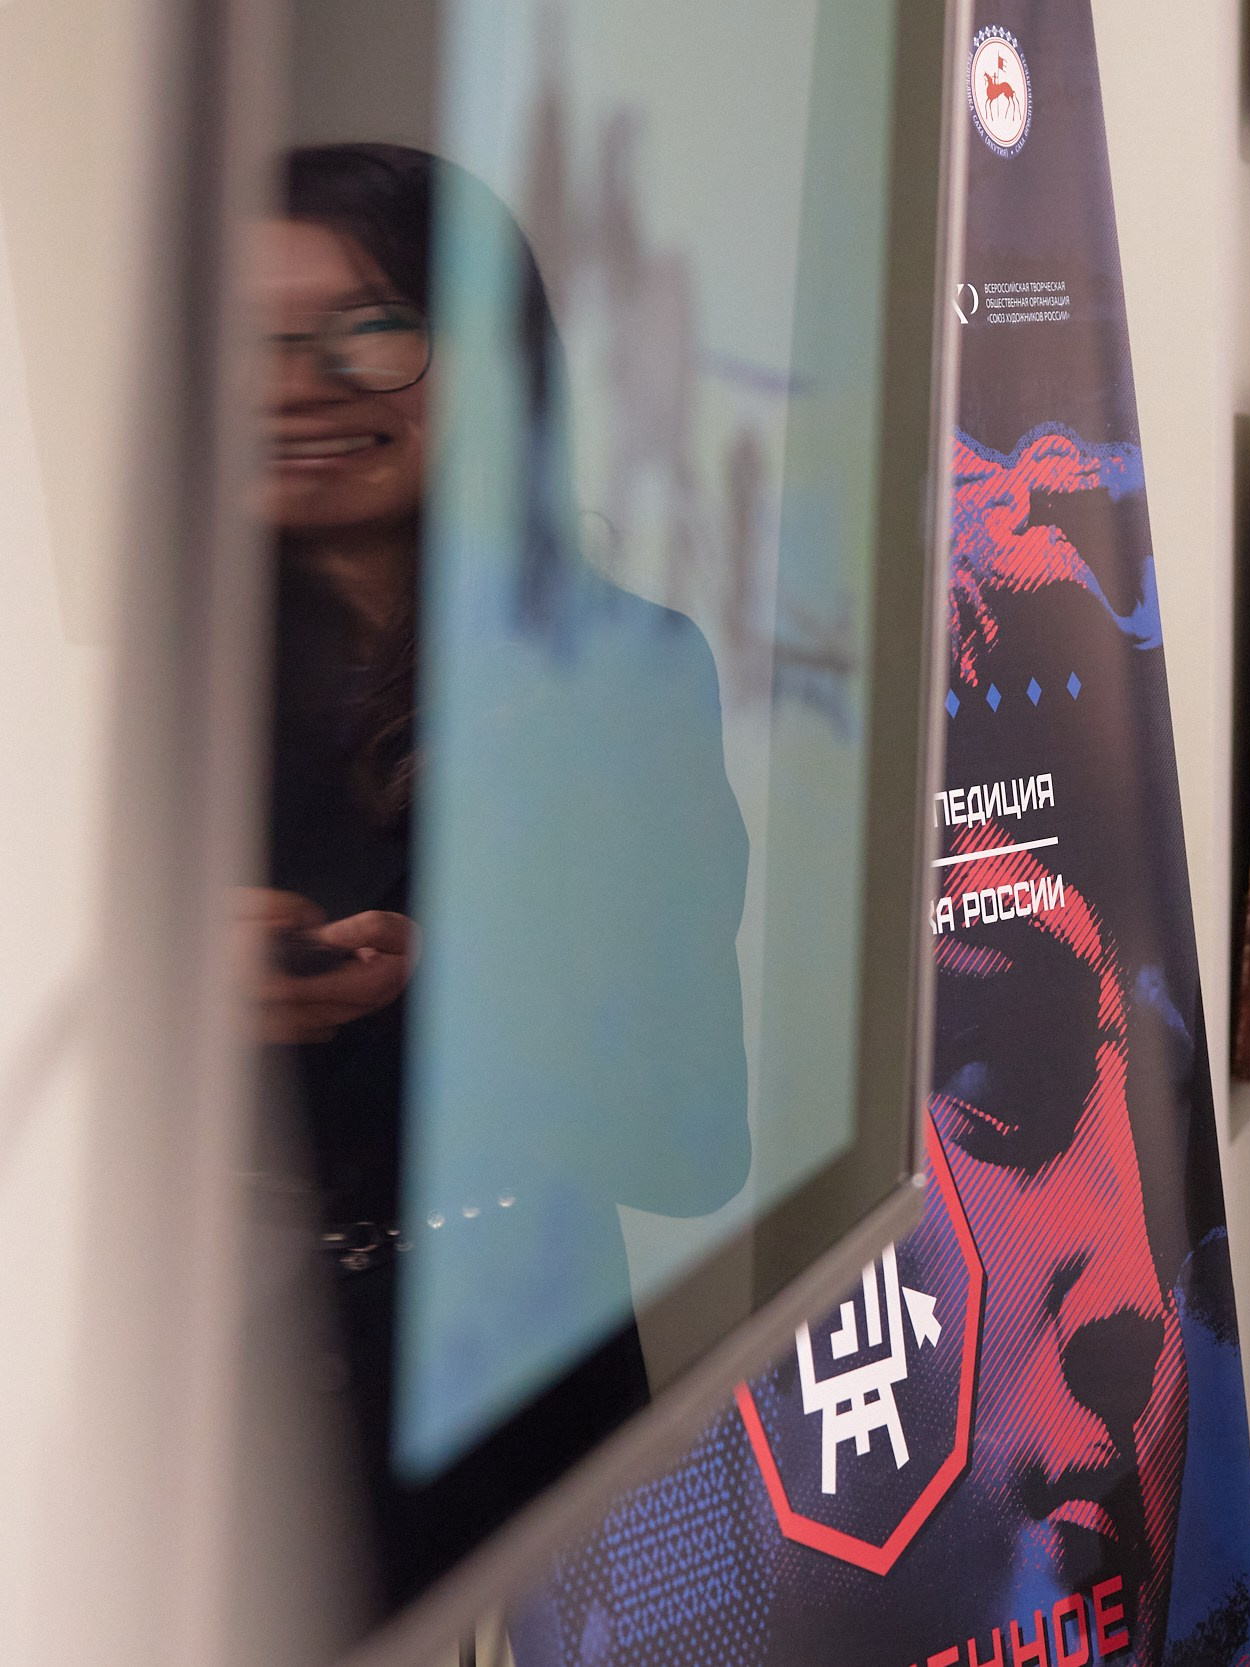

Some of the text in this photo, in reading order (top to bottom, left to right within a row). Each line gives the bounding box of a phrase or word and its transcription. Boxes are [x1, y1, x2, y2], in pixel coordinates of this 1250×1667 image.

[984, 281, 1066, 293] ВСЕРОССИЙСКАЯ ТВОРЧЕСКАЯ
[985, 296, 1070, 309] ОБЩЕСТВЕННАЯ ОРГАНИЗАЦИЯ
[1006, 312, 1044, 323] ХУДОЖНИКОВ
[962, 874, 1065, 928] РОССИИ
